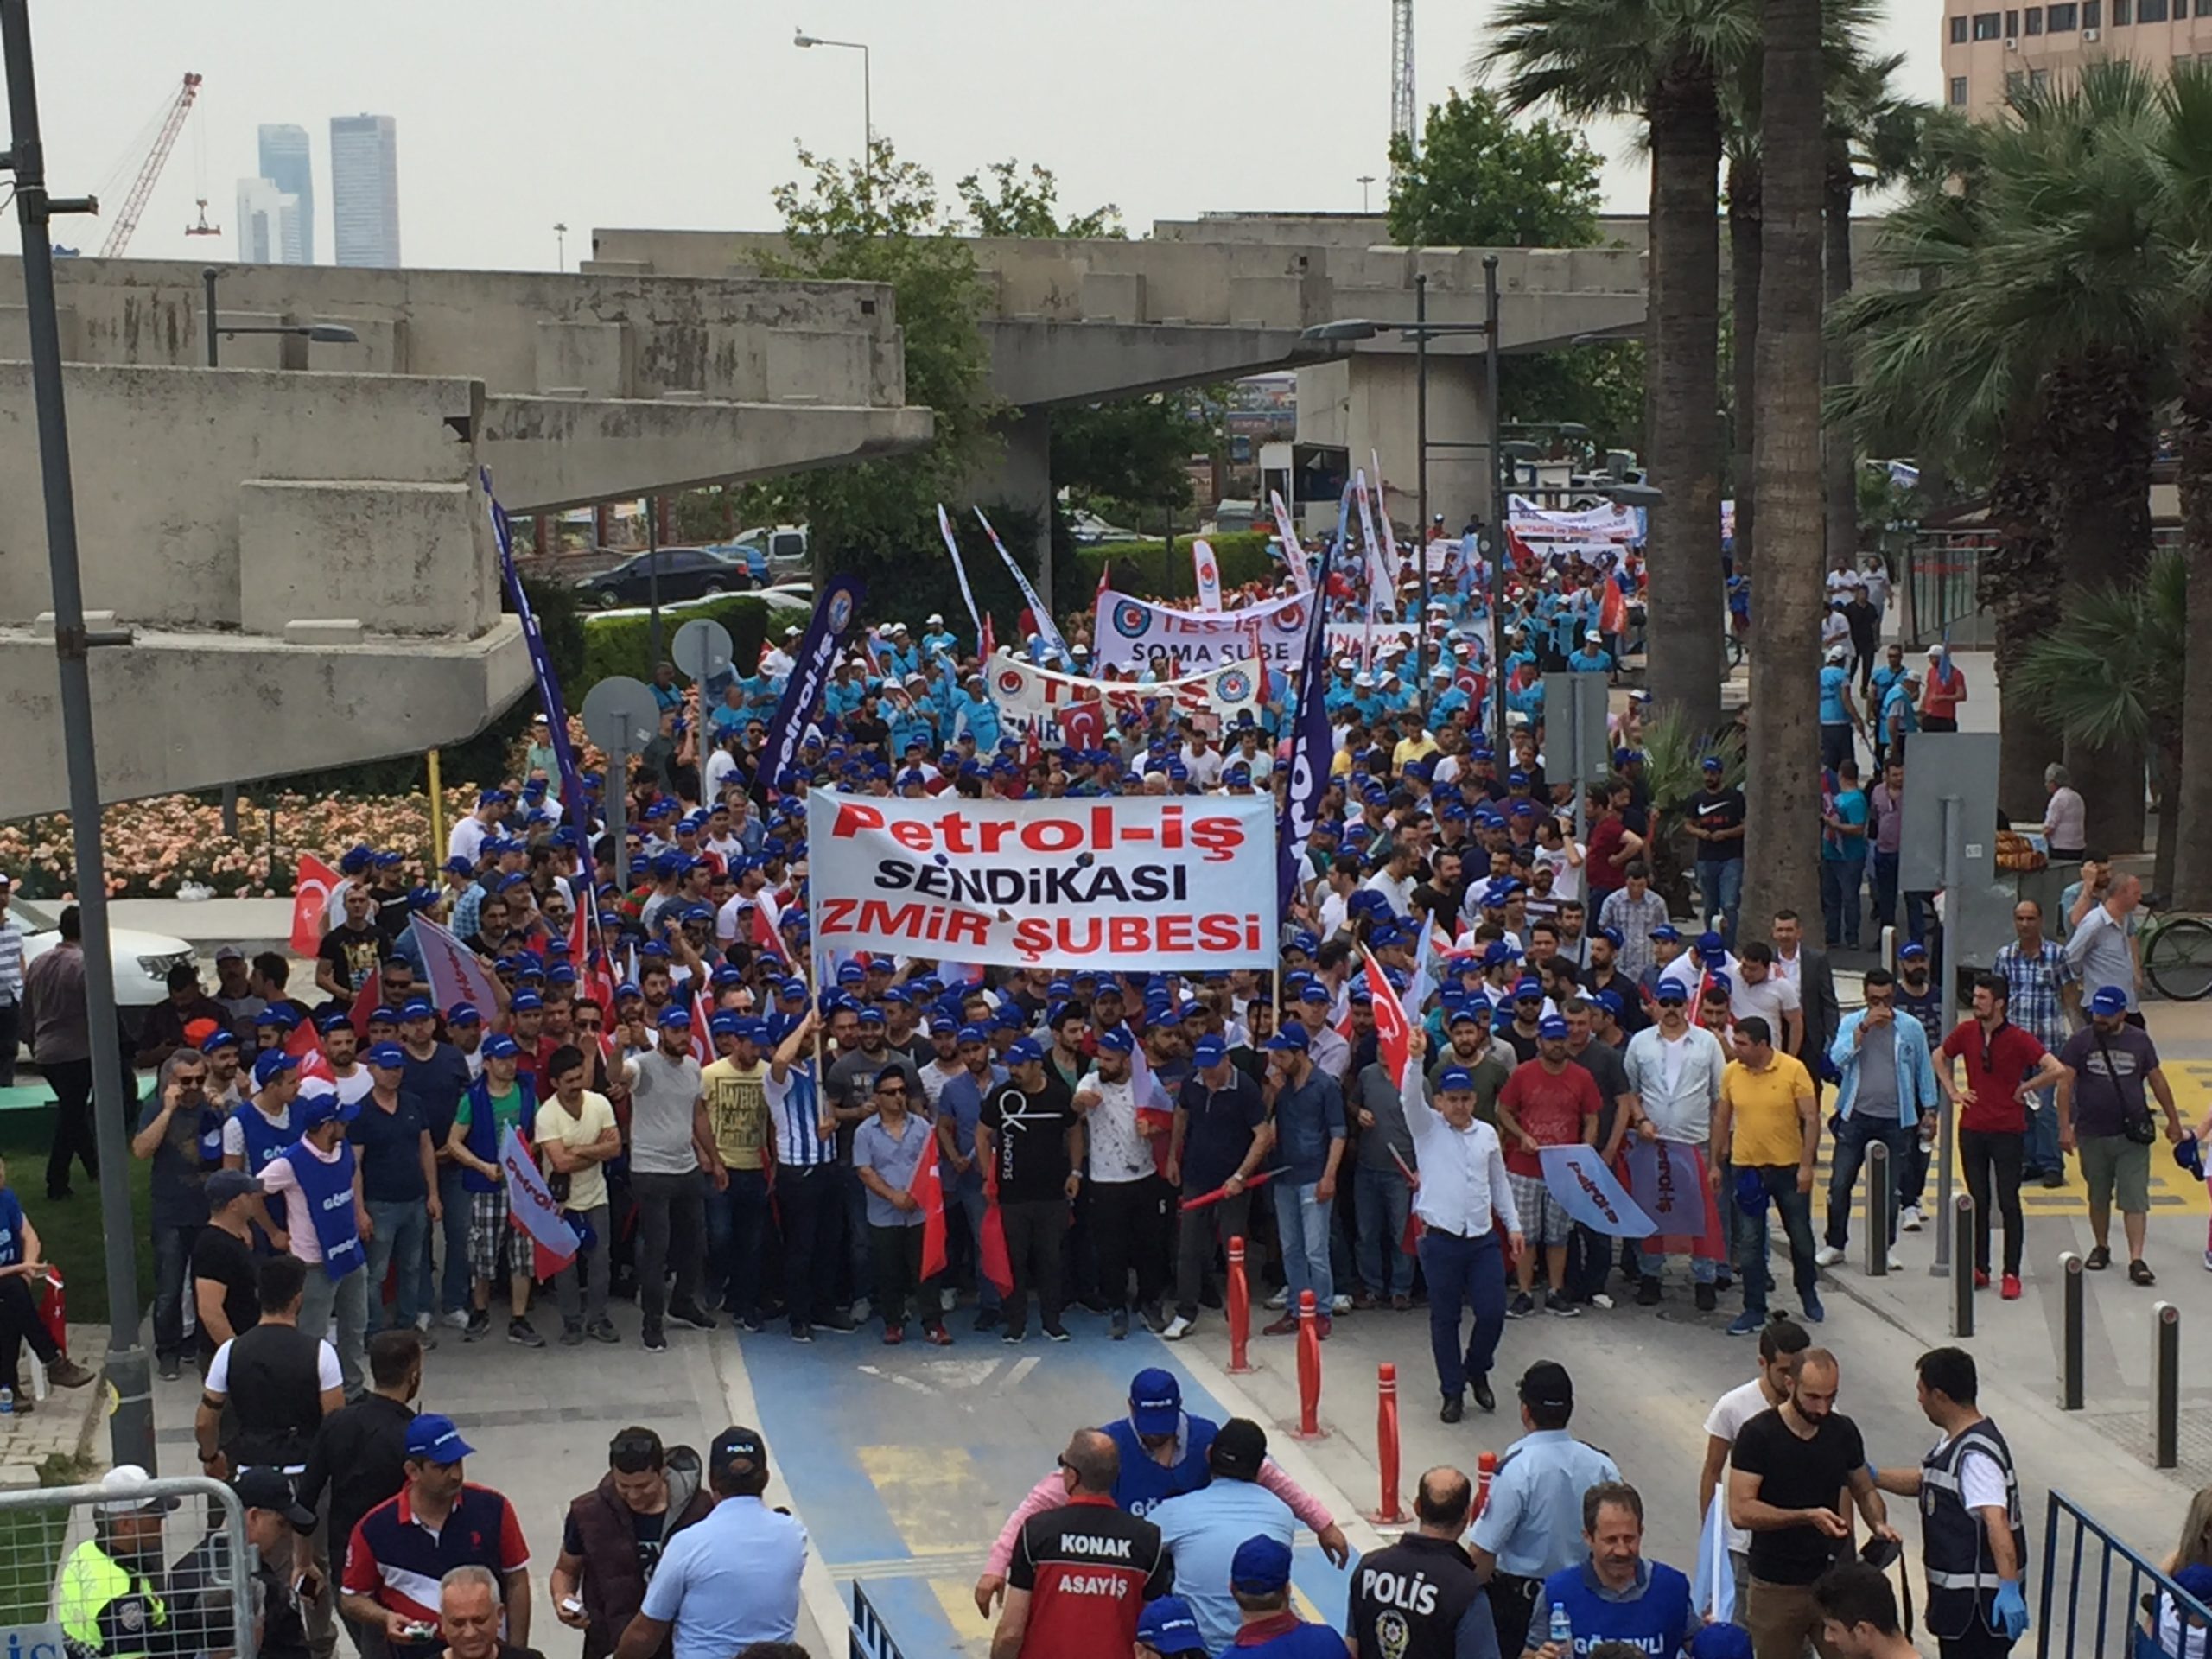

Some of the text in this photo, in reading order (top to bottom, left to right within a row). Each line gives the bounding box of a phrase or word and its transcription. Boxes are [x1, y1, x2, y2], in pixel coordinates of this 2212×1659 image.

[1132, 642, 1213, 663] SOMA
[832, 804, 1245, 862] Petrol-iş
[1061, 1532, 1132, 1559] KONAK
[1058, 1573, 1129, 1600] ASAYİŞ
[1361, 1569, 1440, 1616] POLİS
[1574, 1633, 1664, 1655] GÖVLİ
